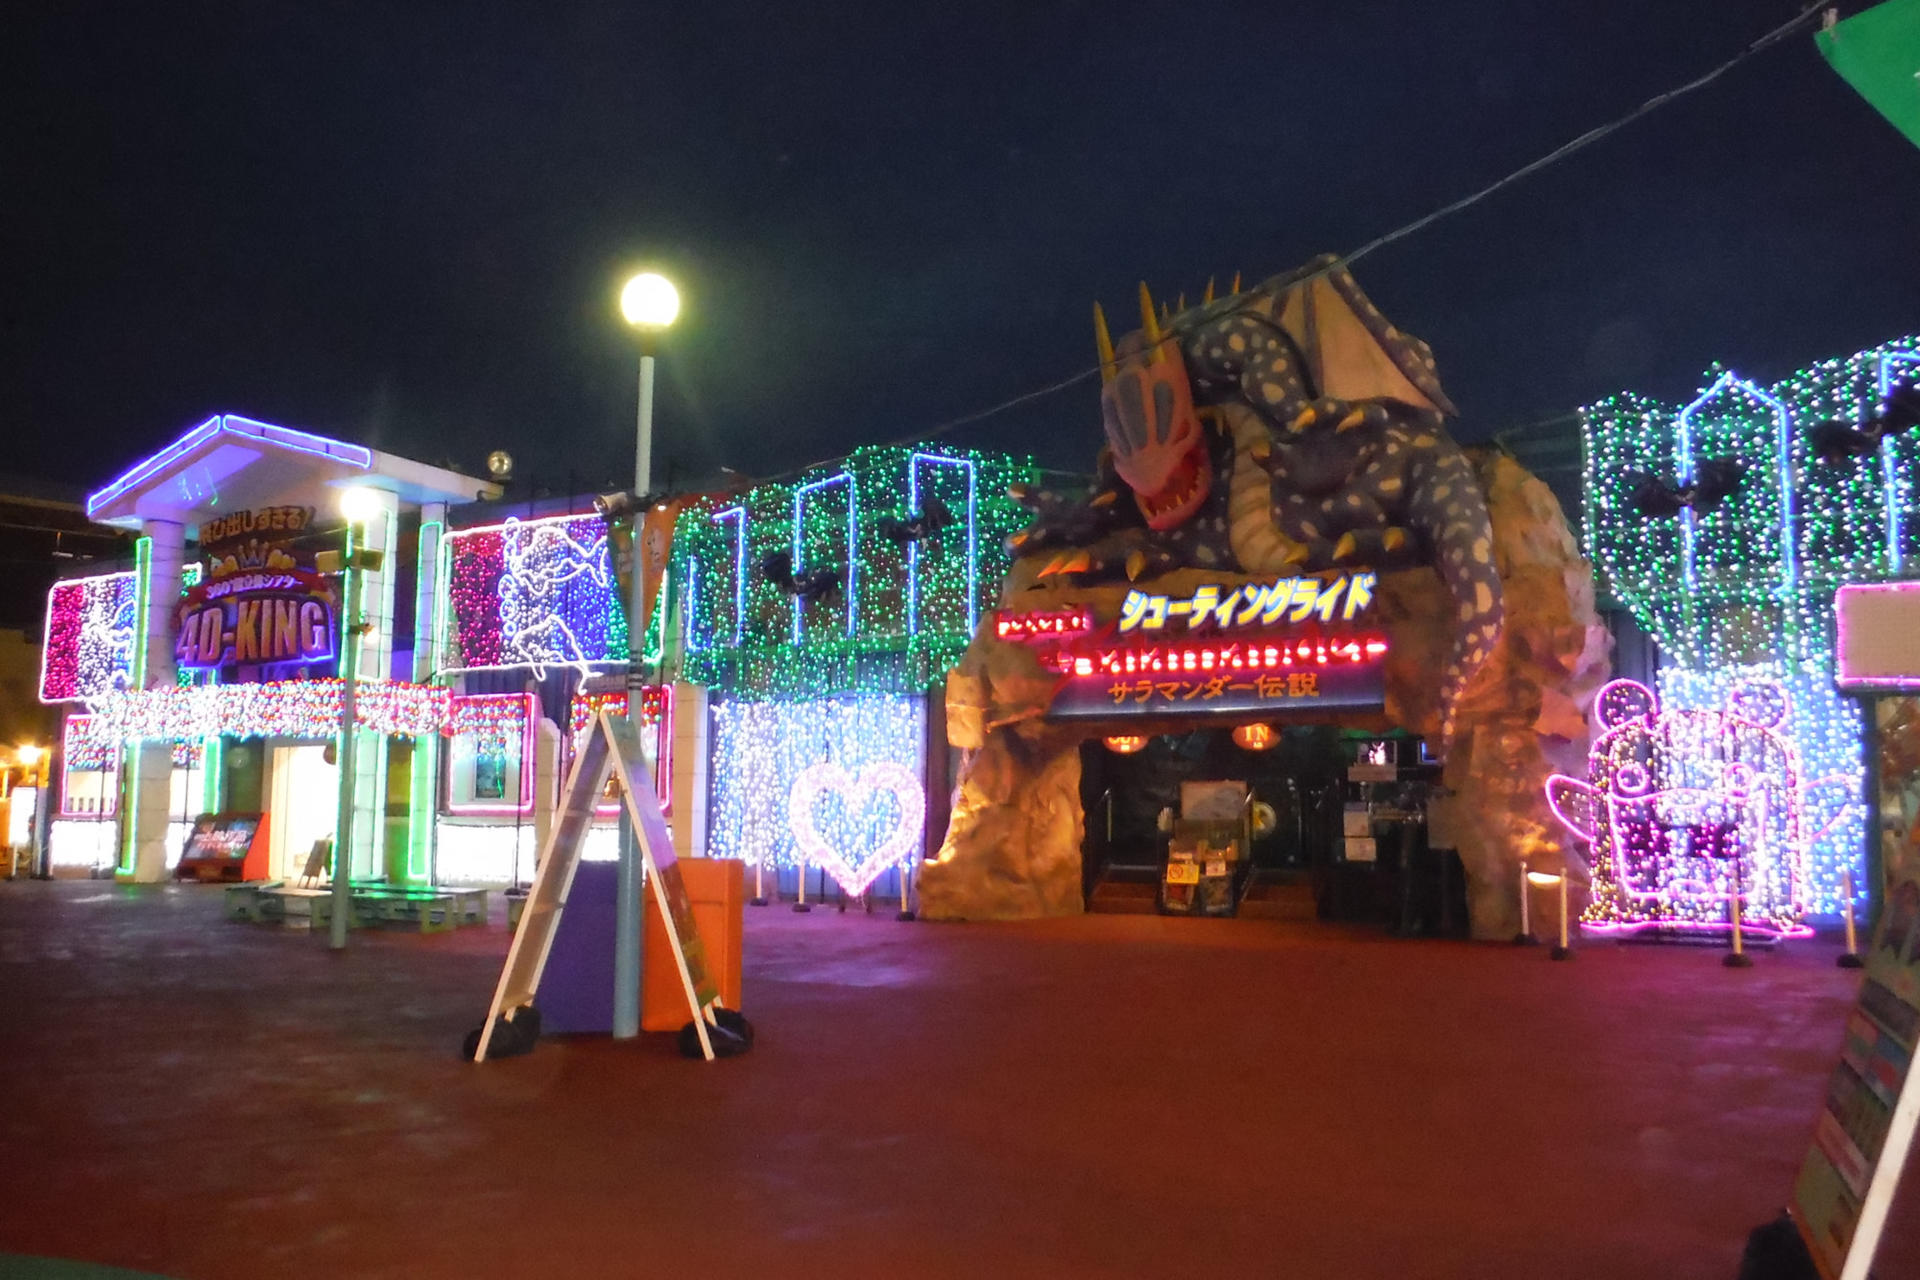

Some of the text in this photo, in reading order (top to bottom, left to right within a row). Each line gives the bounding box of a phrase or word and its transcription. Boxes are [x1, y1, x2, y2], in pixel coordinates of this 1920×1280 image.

[1118, 571, 1377, 632] シューティングライド
[175, 599, 326, 663] 4D-KING
[1108, 672, 1320, 704] サラマンダー伝説
[1245, 726, 1269, 742] IN
